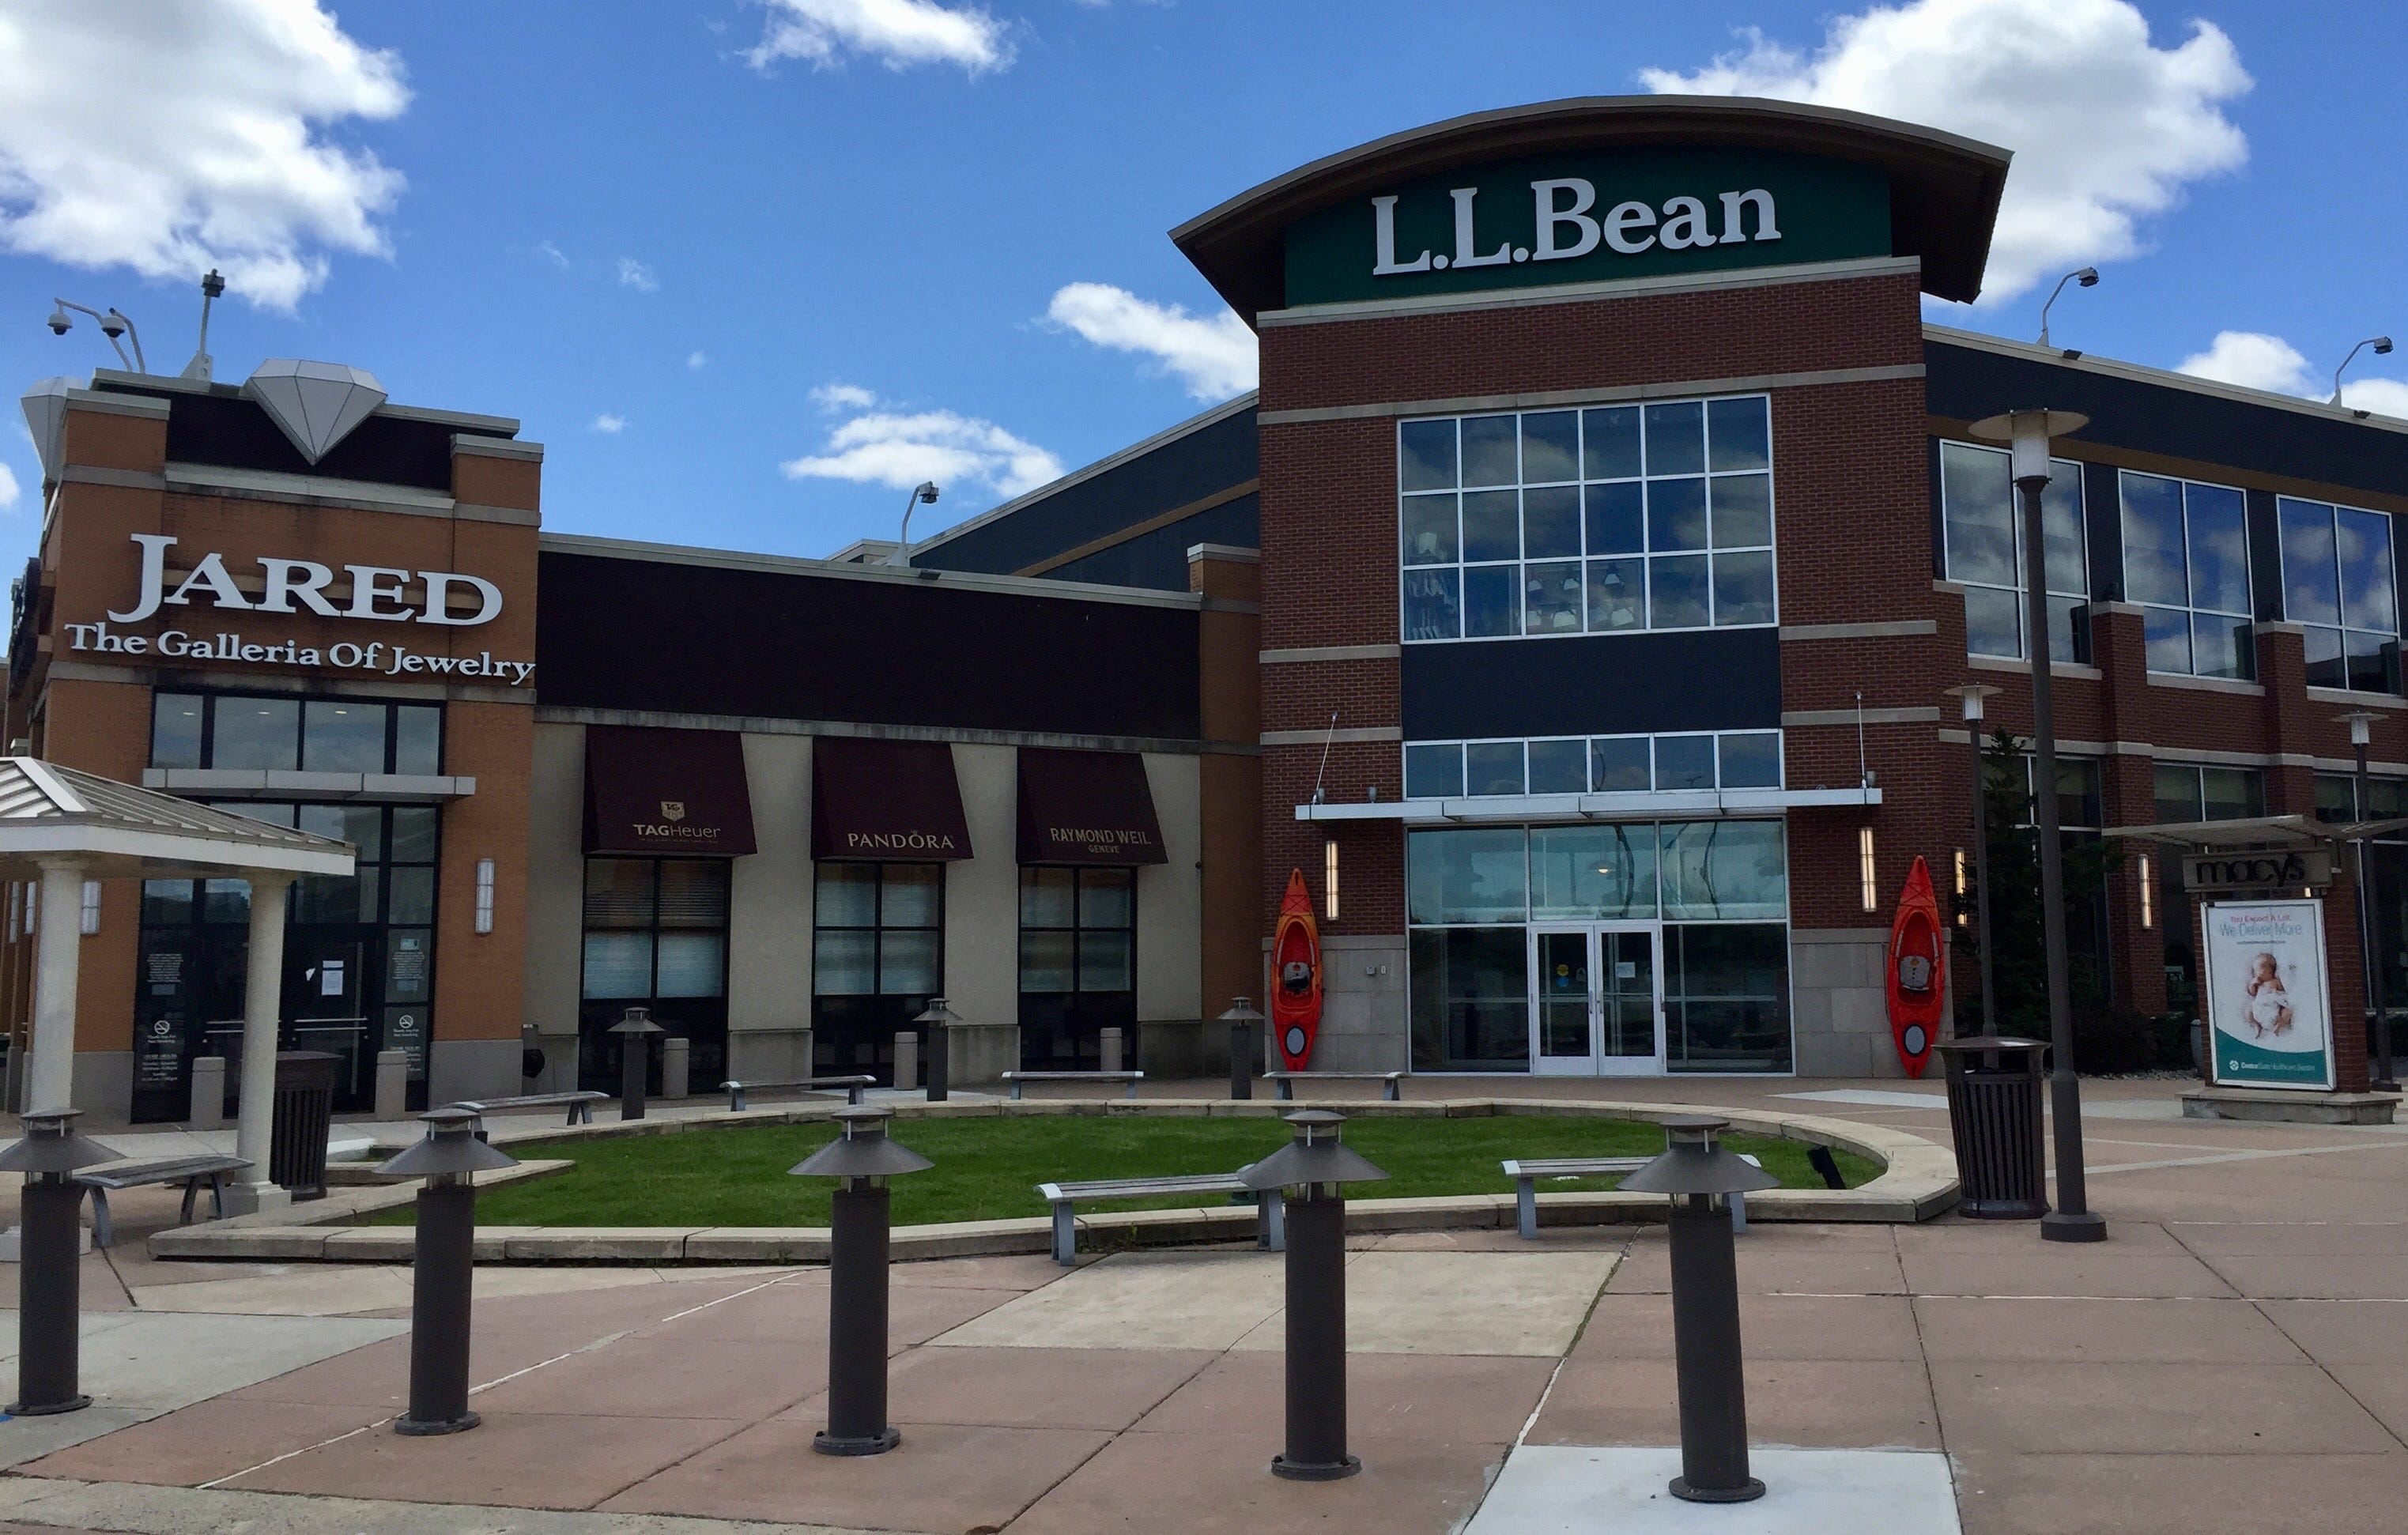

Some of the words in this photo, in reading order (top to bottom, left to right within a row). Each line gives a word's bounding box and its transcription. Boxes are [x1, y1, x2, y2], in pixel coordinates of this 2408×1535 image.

[1372, 178, 1782, 276] L.L.Bean
[107, 533, 504, 627] JARED
[64, 622, 148, 655] The
[157, 631, 321, 667] Galleria
[329, 641, 383, 670] Of
[385, 646, 537, 686] Jewelry
[847, 830, 955, 850] PANDORA
[1050, 828, 1114, 843] RAYMOND
[1115, 831, 1152, 845] WEIL
[2220, 923, 2236, 937] We
